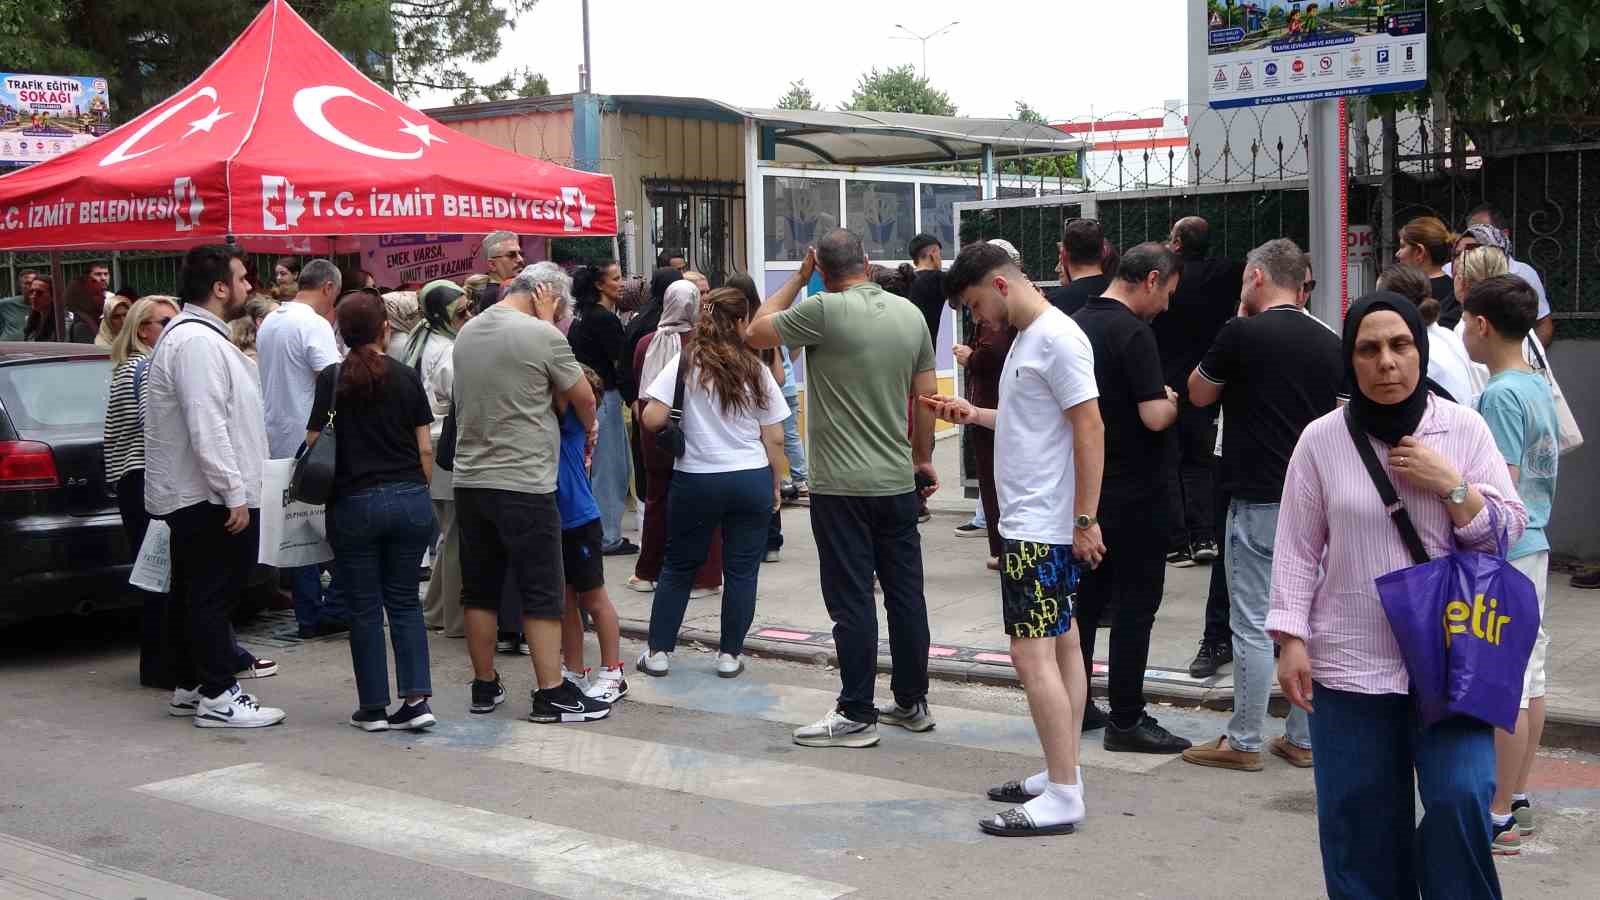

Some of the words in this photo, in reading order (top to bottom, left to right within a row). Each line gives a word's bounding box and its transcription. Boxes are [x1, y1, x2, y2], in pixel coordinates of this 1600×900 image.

[8, 79, 43, 90] TRAFİK
[46, 80, 79, 91] EĞİTİM
[20, 91, 71, 103] SOKAĞI
[0, 206, 24, 231] .C.
[28, 197, 76, 228] İZMİT
[79, 189, 174, 224] BELEDİYESİ
[309, 191, 364, 217] T.C.
[369, 187, 436, 217] İZMİT
[443, 192, 562, 220] BELEDİYESİ
[386, 250, 410, 268] EMEK
[424, 263, 439, 279] HEP
